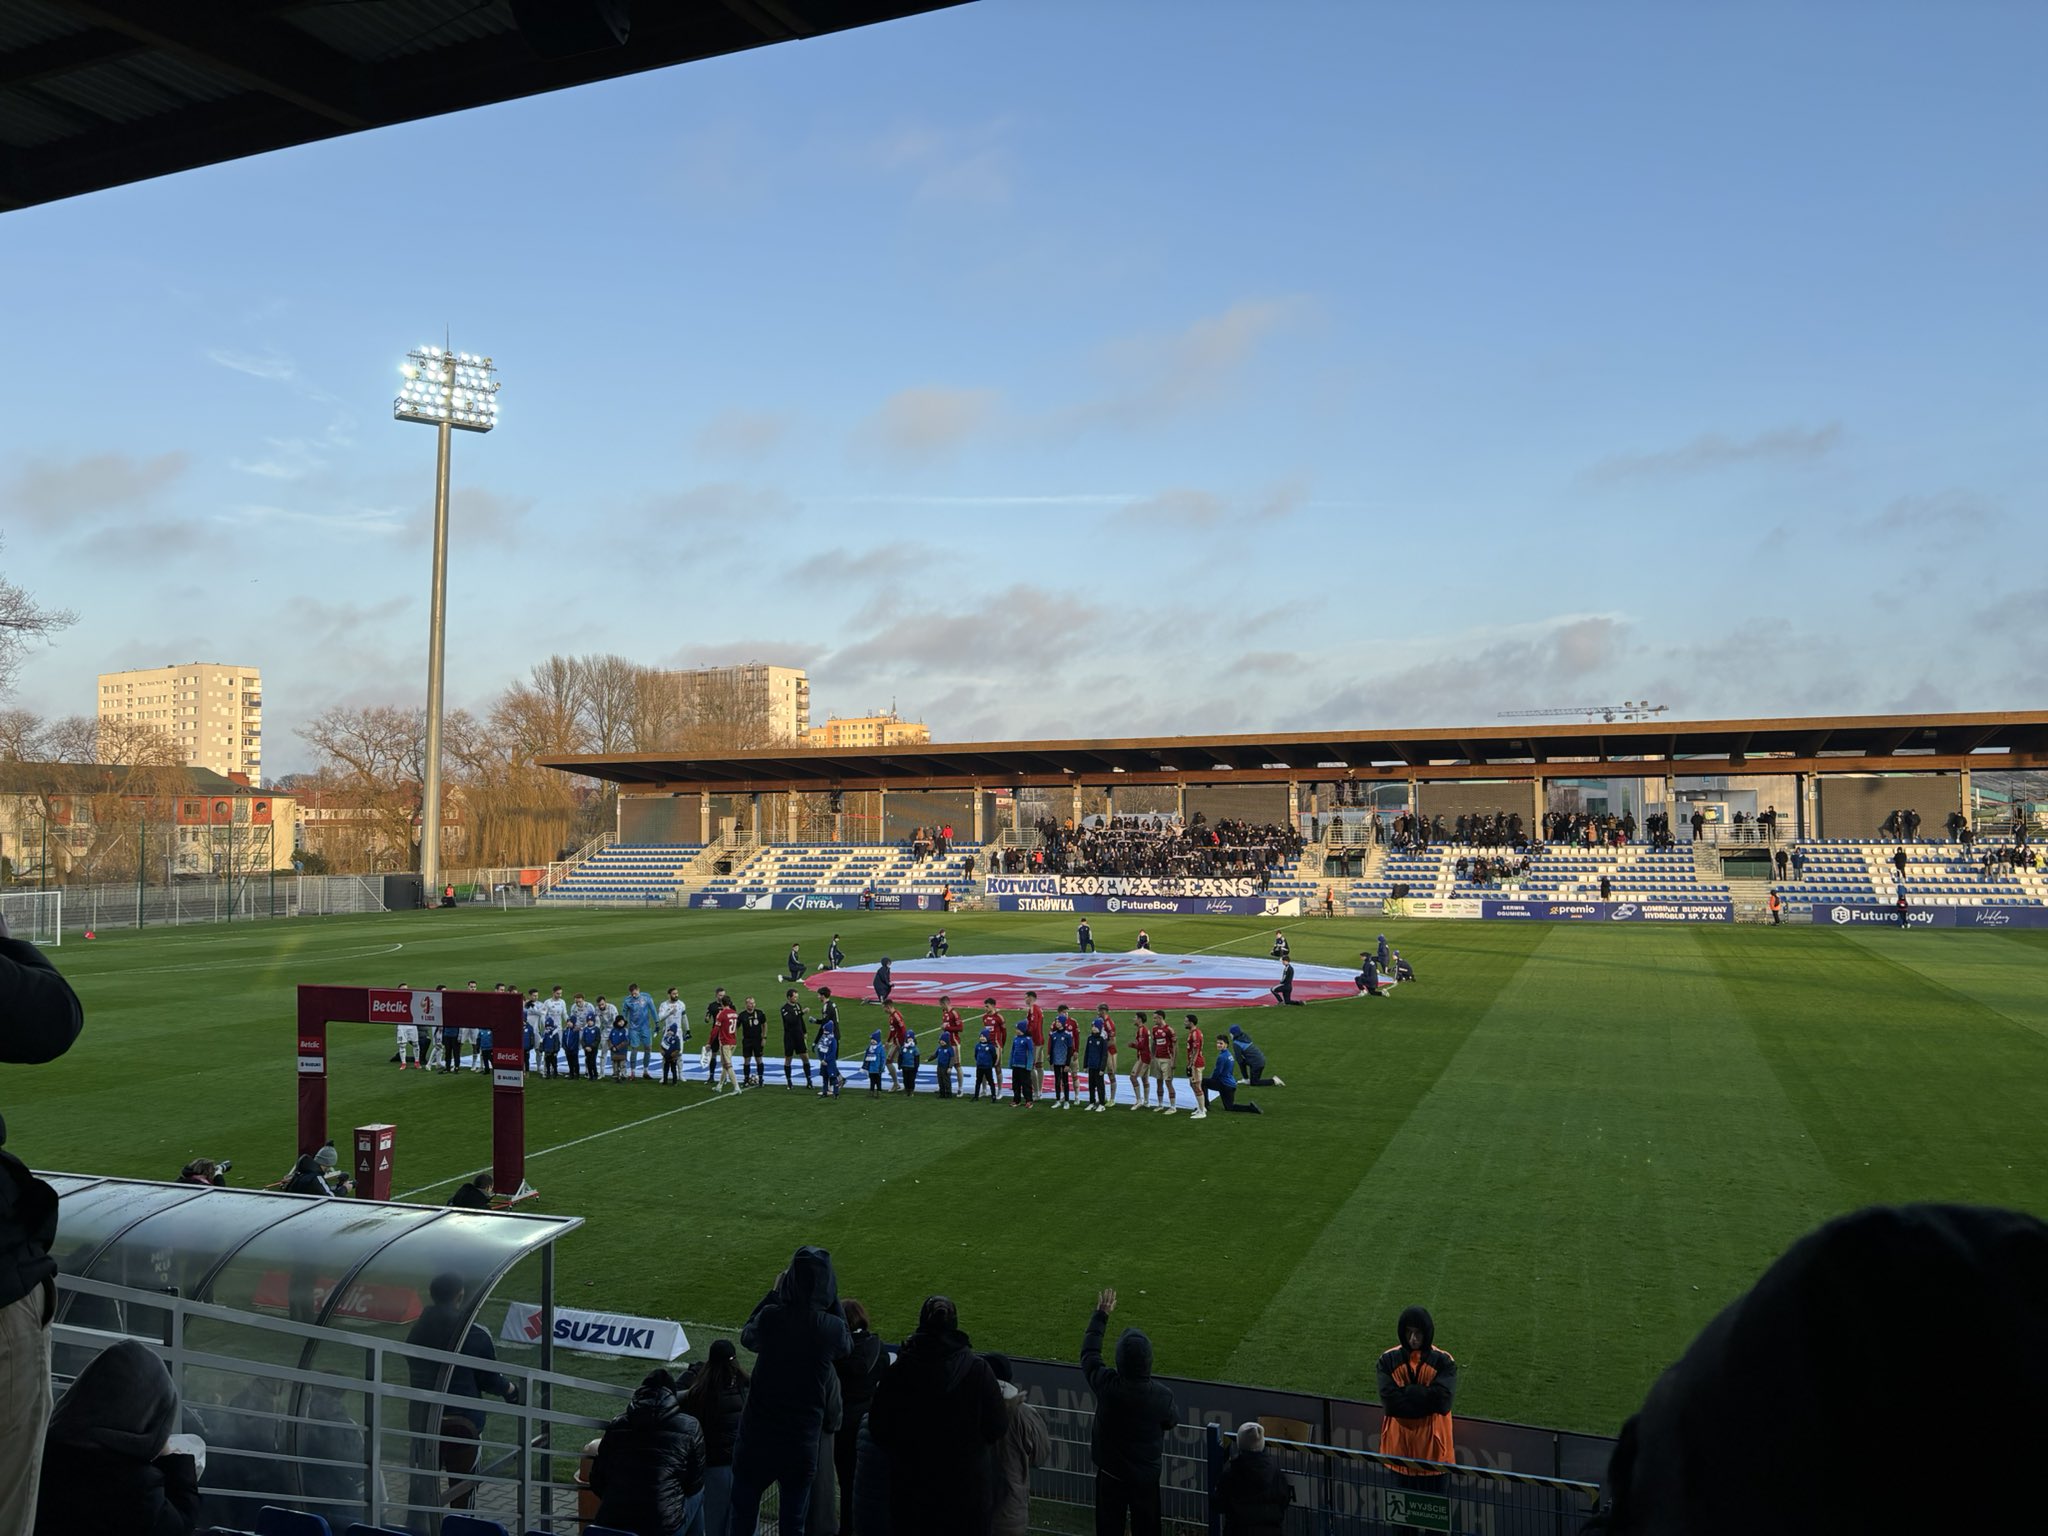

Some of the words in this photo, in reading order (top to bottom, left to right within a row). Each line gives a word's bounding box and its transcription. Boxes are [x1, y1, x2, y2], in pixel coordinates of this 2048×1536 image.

[986, 878, 1059, 895] KOTWICA
[1064, 876, 1157, 896] KOTWA
[1183, 877, 1253, 897] FANS
[806, 900, 843, 910] RYBA.pl
[1121, 900, 1179, 911] FutureBody
[1559, 905, 1595, 915] premio
[1641, 905, 1678, 913] KOMBINAT
[1852, 910, 1934, 923] Futureody
[372, 999, 408, 1013] Betclic
[300, 1040, 320, 1048] Betclic
[497, 1052, 519, 1061] Betclic
[553, 1318, 655, 1350] SUZUKI
